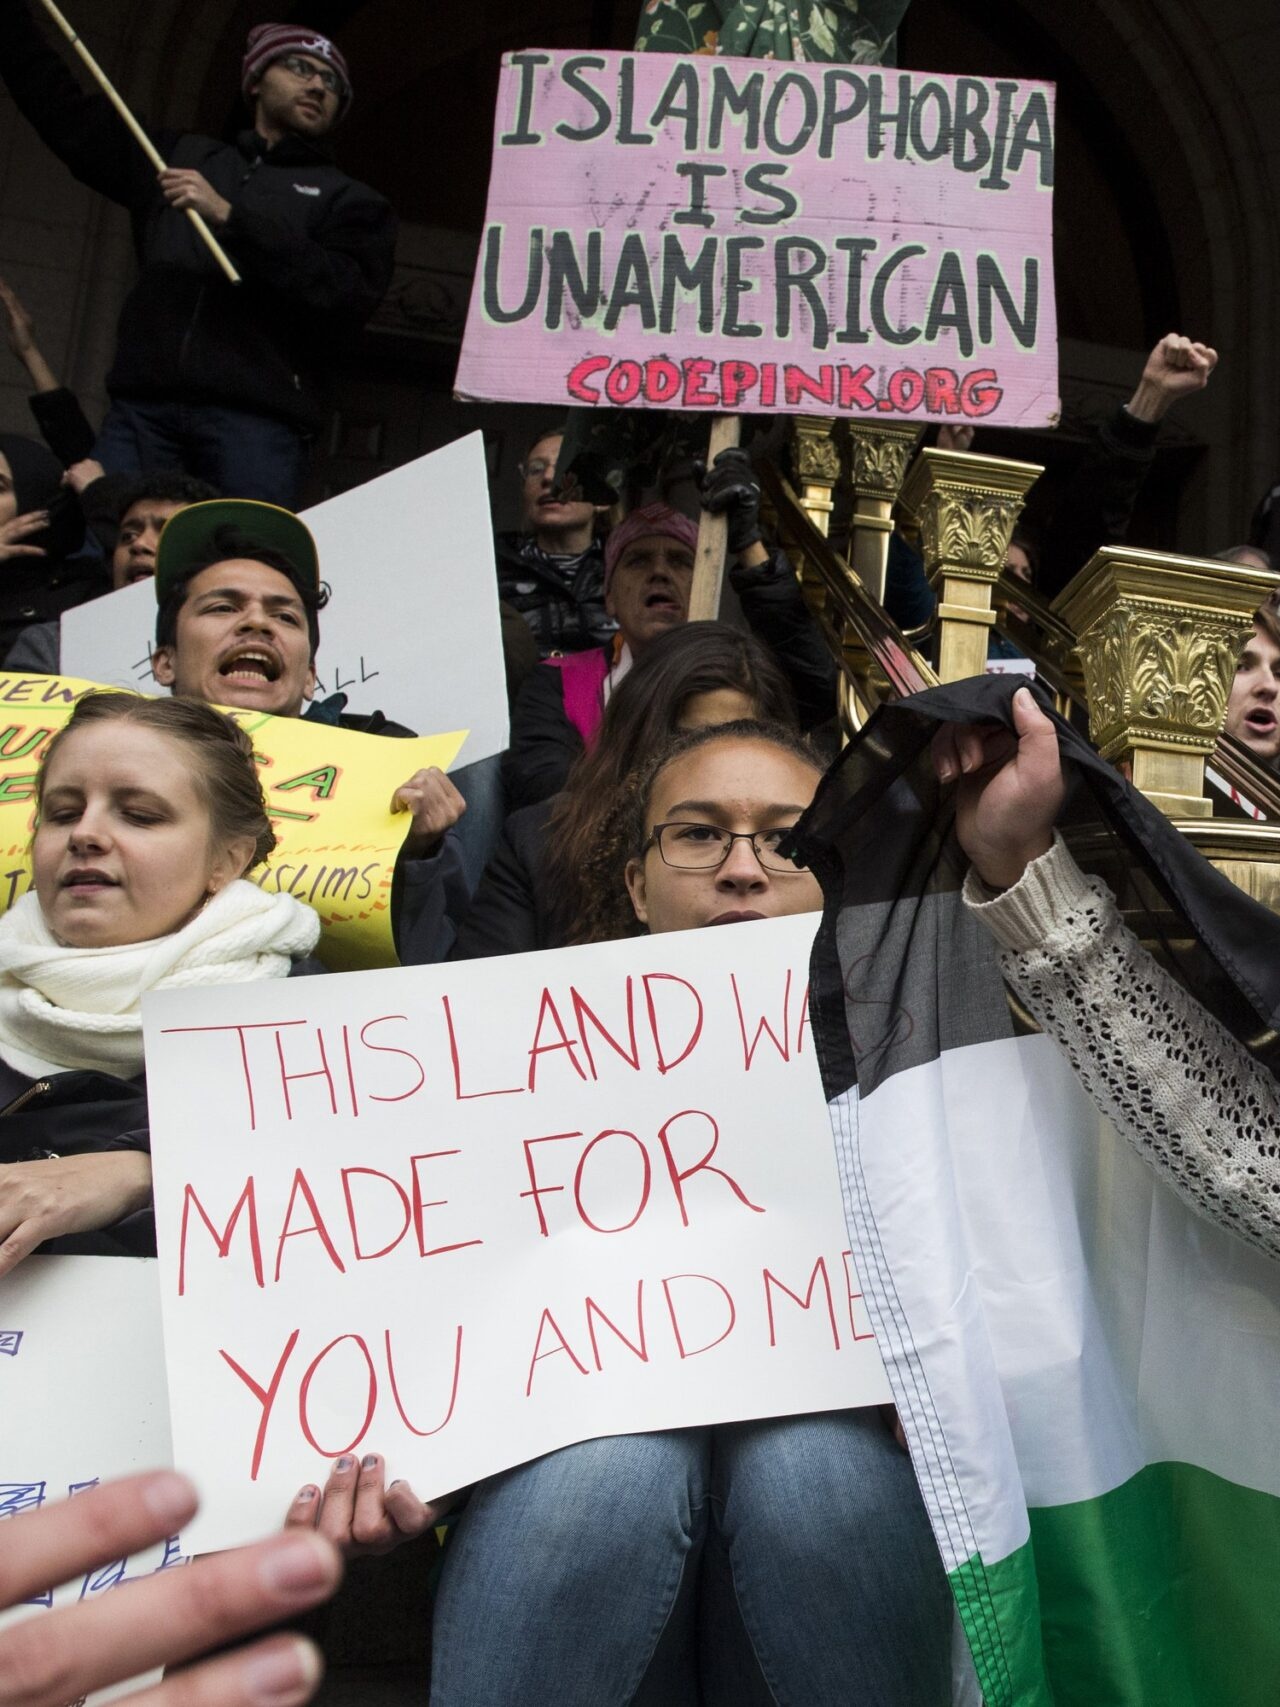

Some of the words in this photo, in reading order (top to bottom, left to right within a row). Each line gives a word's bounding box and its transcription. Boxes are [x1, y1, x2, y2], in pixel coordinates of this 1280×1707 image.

[502, 54, 1054, 190] ISLAMOPHOBIA
[674, 163, 799, 226] IS
[483, 226, 1038, 358] UNAMERICAN
[567, 356, 1003, 417] CODEPINK.ORG
[161, 1015, 424, 1130] THIS
[441, 973, 703, 1100] LAND
[177, 1149, 484, 1297] MADE
[520, 1110, 766, 1238] FOR
[217, 1326, 464, 1482] YOU
[526, 1273, 736, 1398] AND
[762, 1250, 876, 1350] ME
